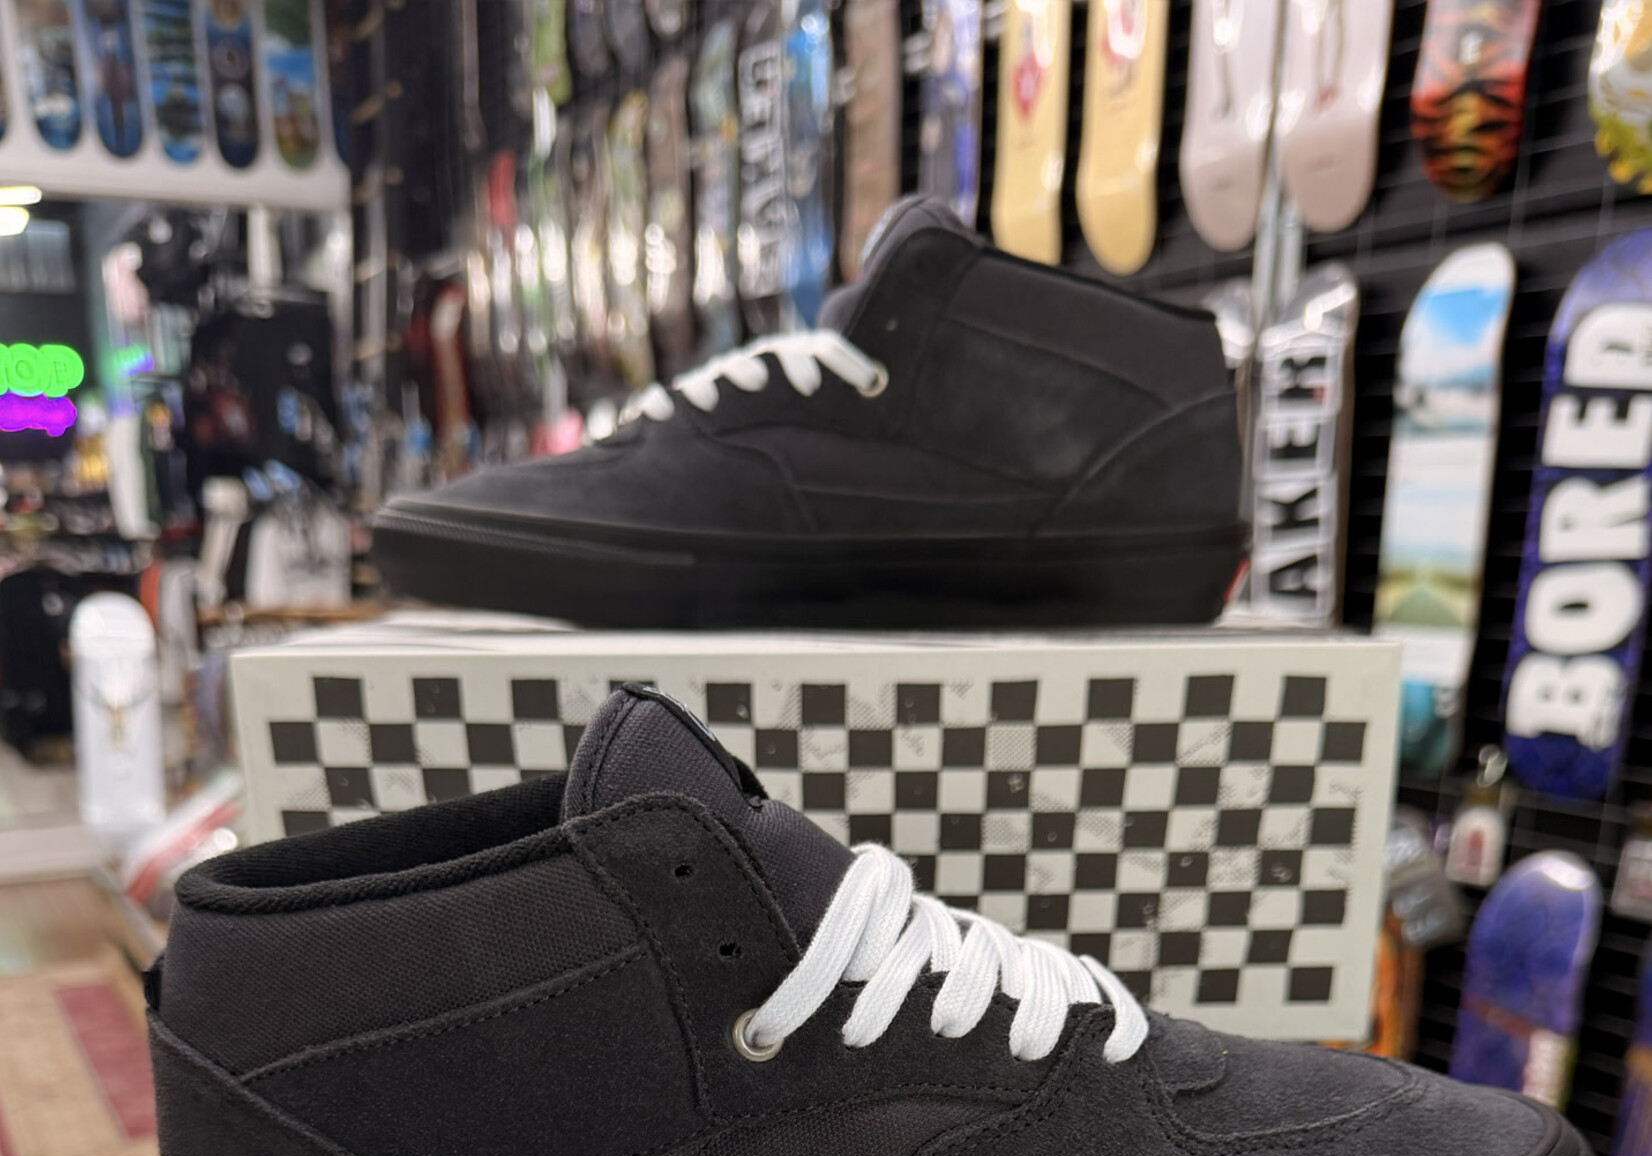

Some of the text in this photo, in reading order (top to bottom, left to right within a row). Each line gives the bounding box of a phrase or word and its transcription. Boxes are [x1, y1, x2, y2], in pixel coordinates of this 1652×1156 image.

[0, 343, 84, 397] OP
[1260, 350, 1331, 603] AKER
[1505, 300, 1652, 752] BORED
